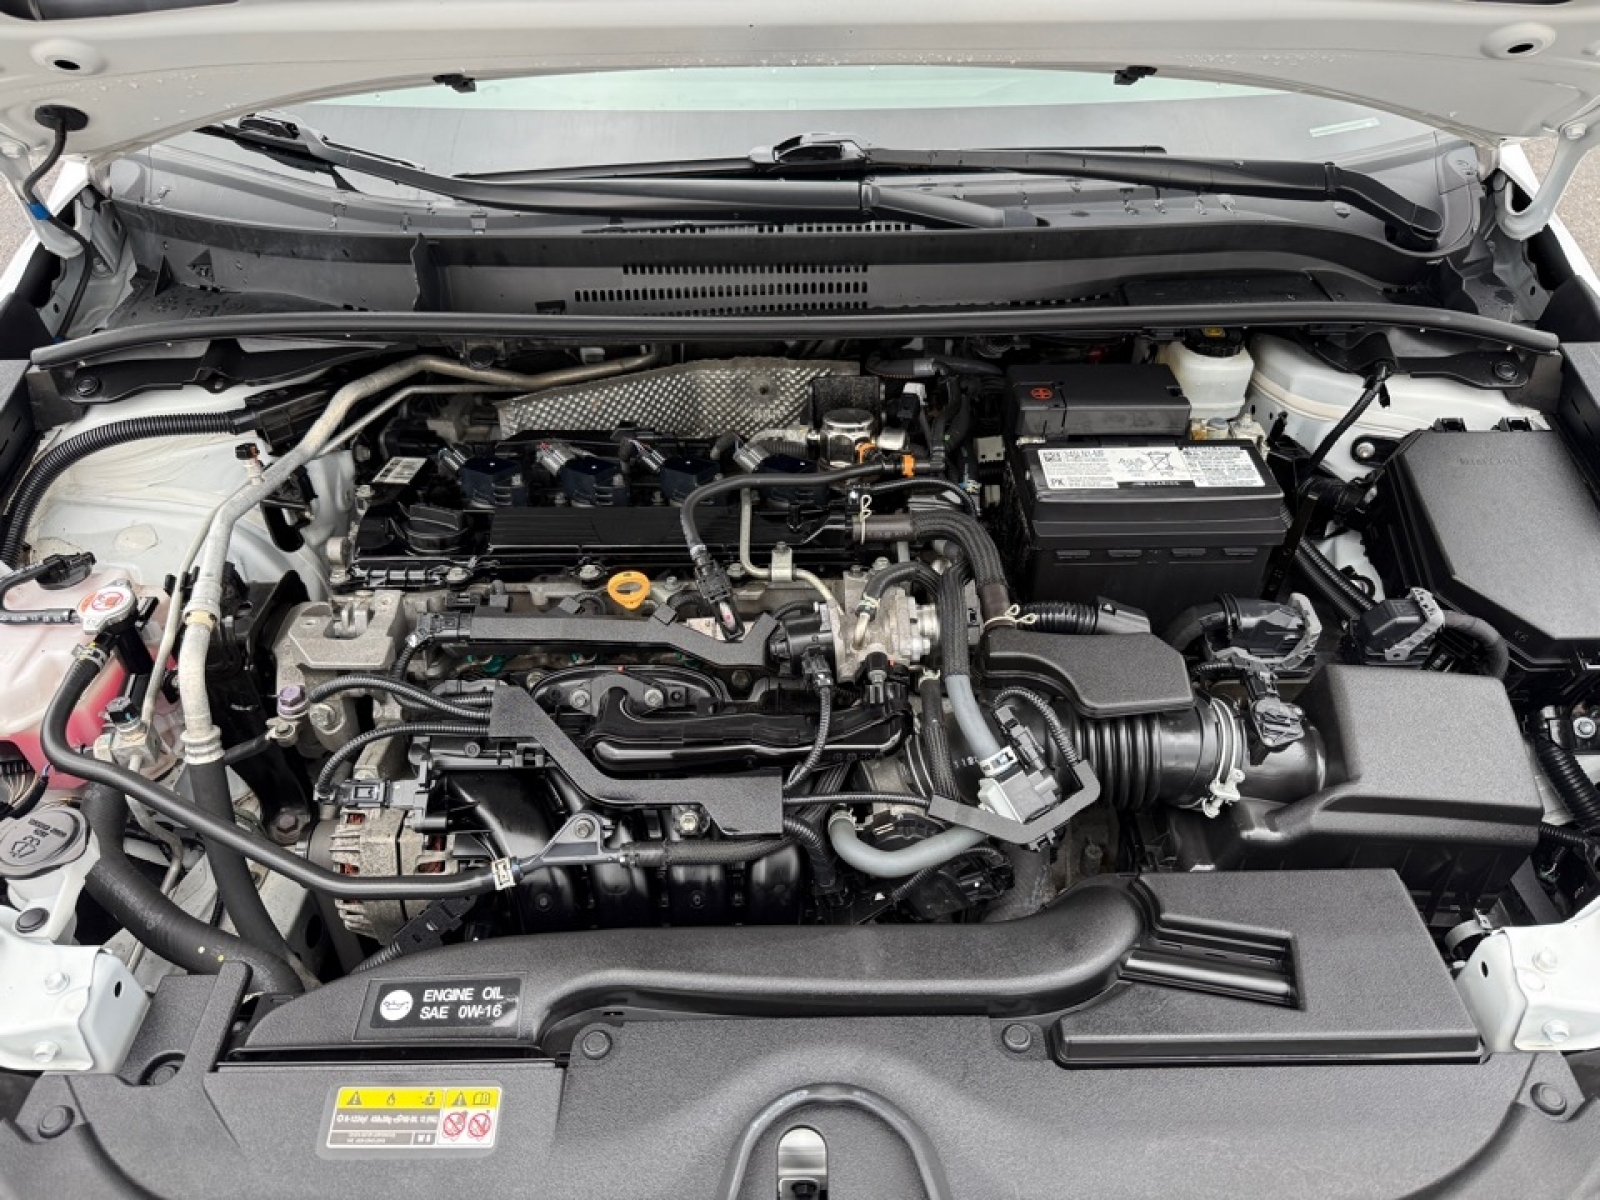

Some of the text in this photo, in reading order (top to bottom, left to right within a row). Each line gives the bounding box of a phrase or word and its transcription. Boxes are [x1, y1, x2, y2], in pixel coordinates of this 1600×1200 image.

[422, 986, 504, 1003] ENGINE OIL
[419, 1004, 503, 1020] SAE 0W-16
